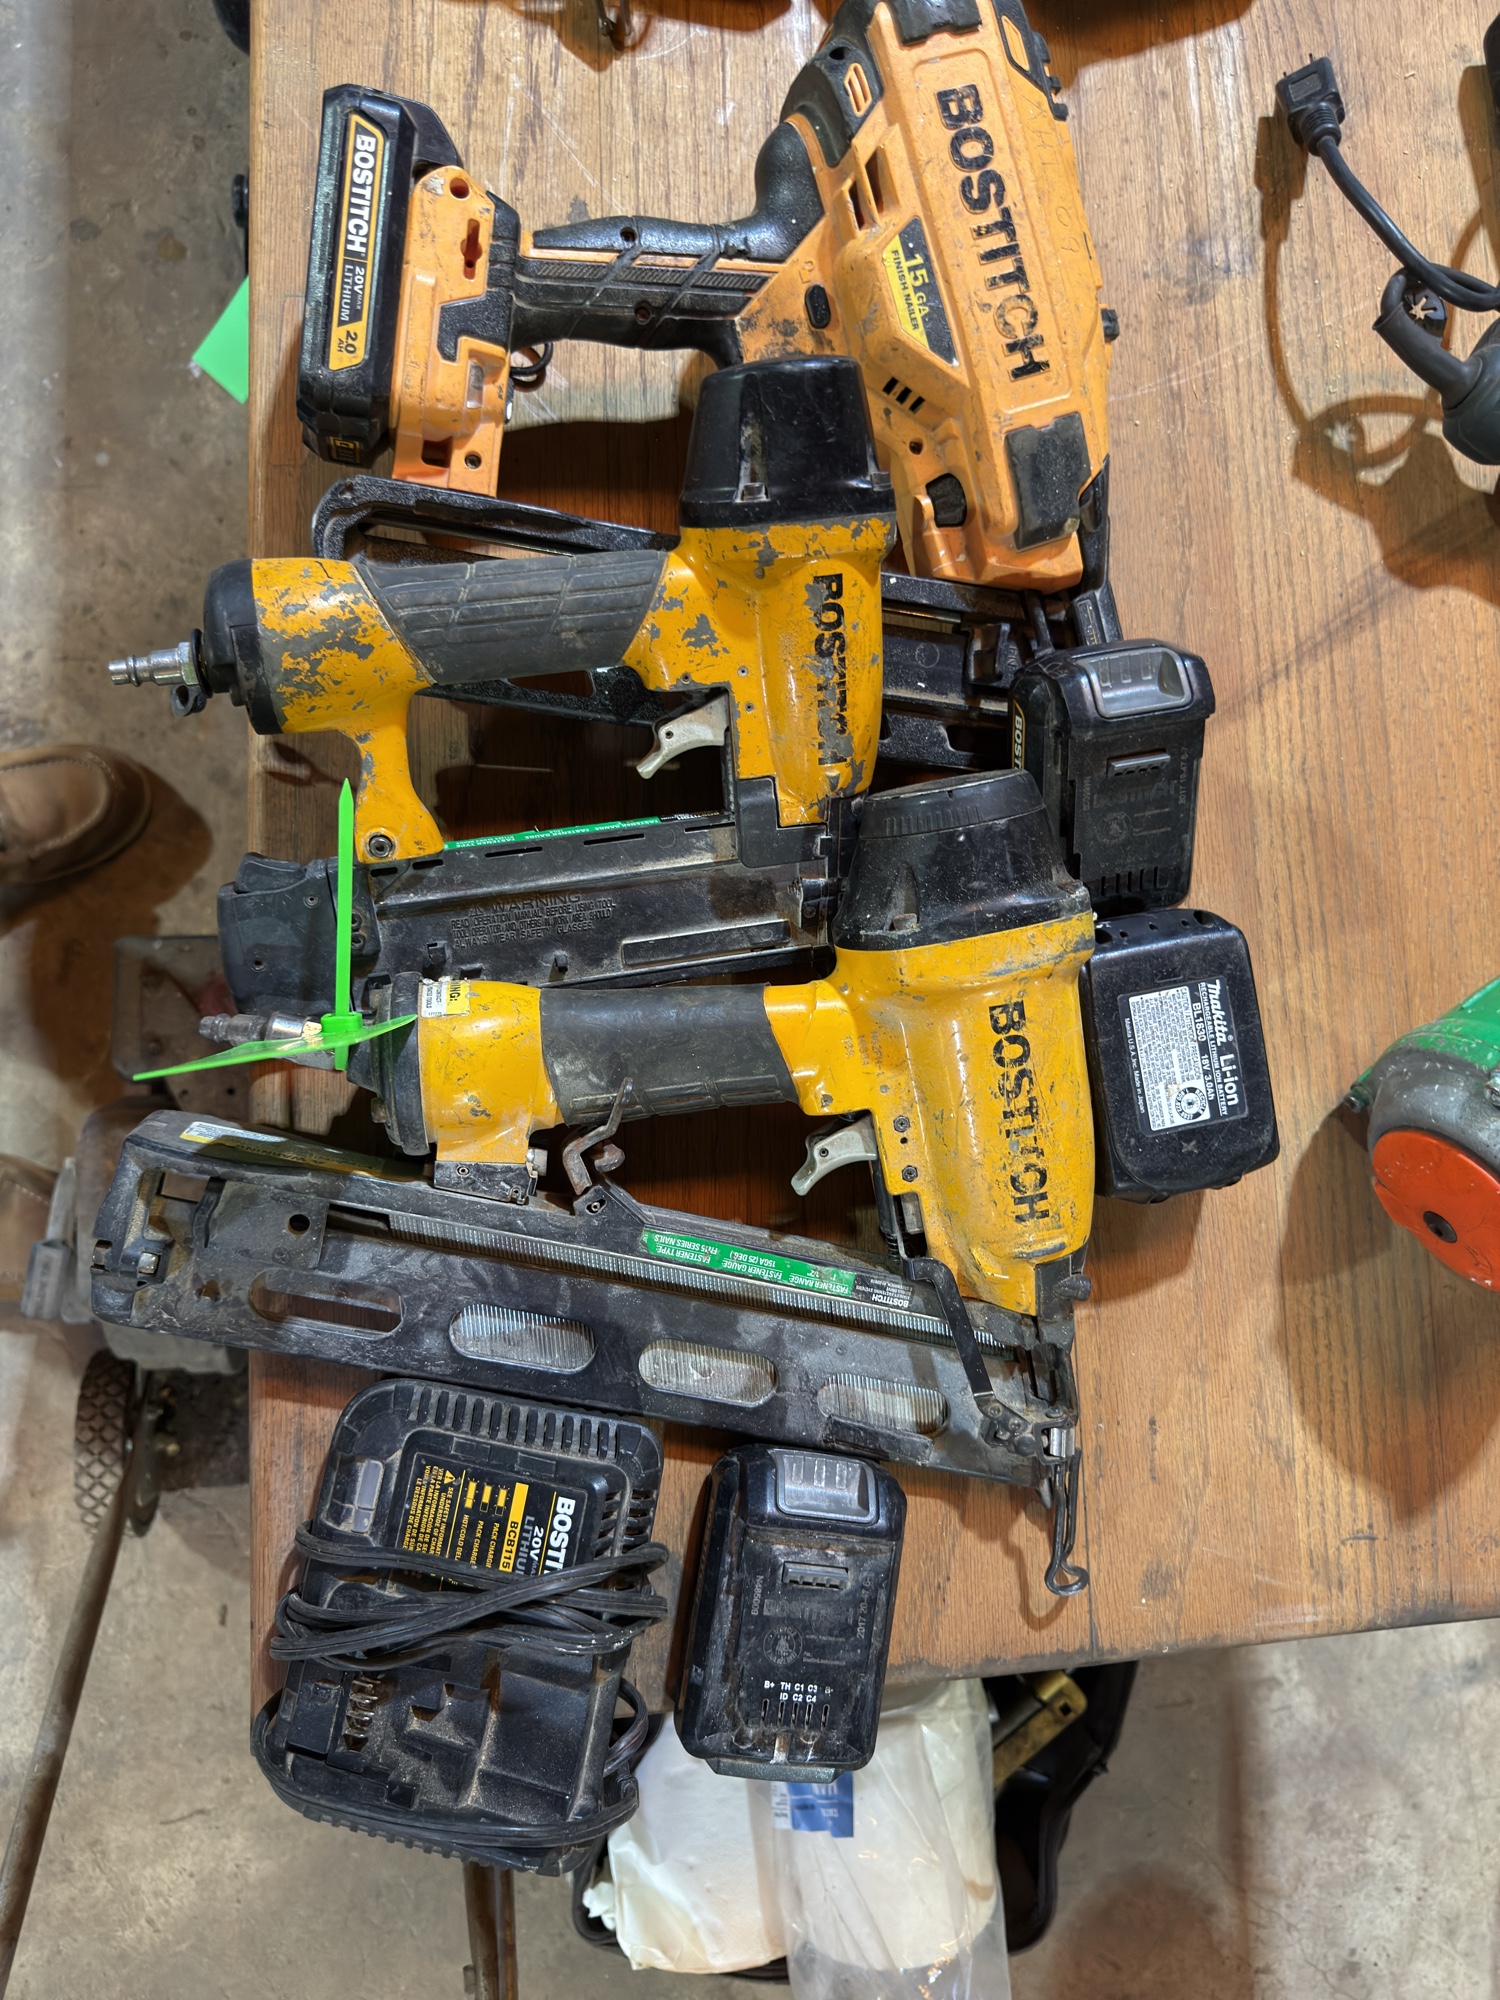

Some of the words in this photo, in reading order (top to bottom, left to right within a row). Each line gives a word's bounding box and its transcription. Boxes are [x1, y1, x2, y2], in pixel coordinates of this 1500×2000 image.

[346, 135, 376, 252] BOSTITCH
[935, 84, 1051, 382] BOSTITCH
[905, 253, 929, 286] 15
[354, 266, 365, 295] 20V
[891, 249, 908, 290] FINISH
[903, 294, 919, 331] NAILER
[340, 264, 353, 321] LITHIUM
[914, 292, 930, 316] GA
[336, 337, 344, 353] AH
[345, 330, 357, 355] 2.0
[1014, 716, 1023, 769] BOST
[491, 891, 581, 913] WARNING
[451, 919, 469, 930] READ
[474, 912, 512, 926] OPERATION
[514, 909, 542, 922] MANUAL
[546, 905, 572, 917] BEFORE
[576, 902, 594, 913] USING
[597, 898, 616, 909] TOOL
[520, 919, 543, 931] OTHERS
[454, 936, 490, 949] ALWAYS
[493, 932, 517, 944] WEAR
[1181, 988, 1191, 1011] CAUTION
[1124, 1018, 1133, 1038] Makita
[1185, 1015, 1196, 1042] ATTENTION
[1192, 1002, 1206, 1042] BL1830
[1200, 982, 1215, 1039] RECHARGEABLE
[1209, 1040, 1221, 1069] LITHIUM
[1217, 1084, 1227, 1115] BATTERY
[1201, 1054, 1210, 1070] 18V
[1133, 1071, 1141, 1087] Made
[1204, 1075, 1215, 1100] 3.0Ah
[1219, 1054, 1239, 1106] Li-ion
[989, 1000, 1049, 1224] BOSTITCH
[1136, 1095, 1146, 1114] Japan
[654, 1234, 675, 1245] NAILS
[677, 1239, 700, 1250] SERIES
[655, 1245, 675, 1256] TYPE:
[676, 1250, 711, 1264] FASTENER
[748, 1255, 758, 1264] (25
[722, 1260, 747, 1271] GAUGE:
[748, 1266, 782, 1280] FASTENER
[759, 1258, 776, 1268] 15GA
[789, 1276, 814, 1287] RANGE:
[815, 1280, 849, 1294] FASTENER
[872, 1294, 909, 1307] BOSTITCH
[425, 1485, 435, 1503] PARTE
[435, 1481, 442, 1489] LA
[446, 1487, 454, 1499] SEE
[410, 1486, 420, 1514] DESSOUS
[434, 1492, 446, 1527] UNDERSIDE
[408, 1515, 414, 1524] DE
[419, 1504, 431, 1532] INFERIOR
[425, 1490, 440, 1533] INFORMACIÓN
[441, 1499, 450, 1522] SAFETY
[411, 1528, 417, 1537] DE
[418, 1533, 424, 1542] DE
[425, 1534, 431, 1542] DE
[433, 1528, 439, 1537] OF
[457, 1514, 470, 1546] HOT/COLD
[474, 1520, 484, 1538] PACK
[490, 1522, 500, 1540] PACK
[470, 1539, 481, 1567] CHARGE
[502, 1520, 519, 1569] BCB115
[531, 1526, 544, 1560] 20V
[751, 1575, 764, 1616] N485009
[857, 1616, 866, 1639] 2017
[764, 1680, 775, 1688] B+
[780, 1682, 791, 1690] TH
[795, 1683, 804, 1691] C1
[808, 1685, 818, 1693] C3
[780, 1692, 788, 1700] ID
[806, 1695, 816, 1703] C4
